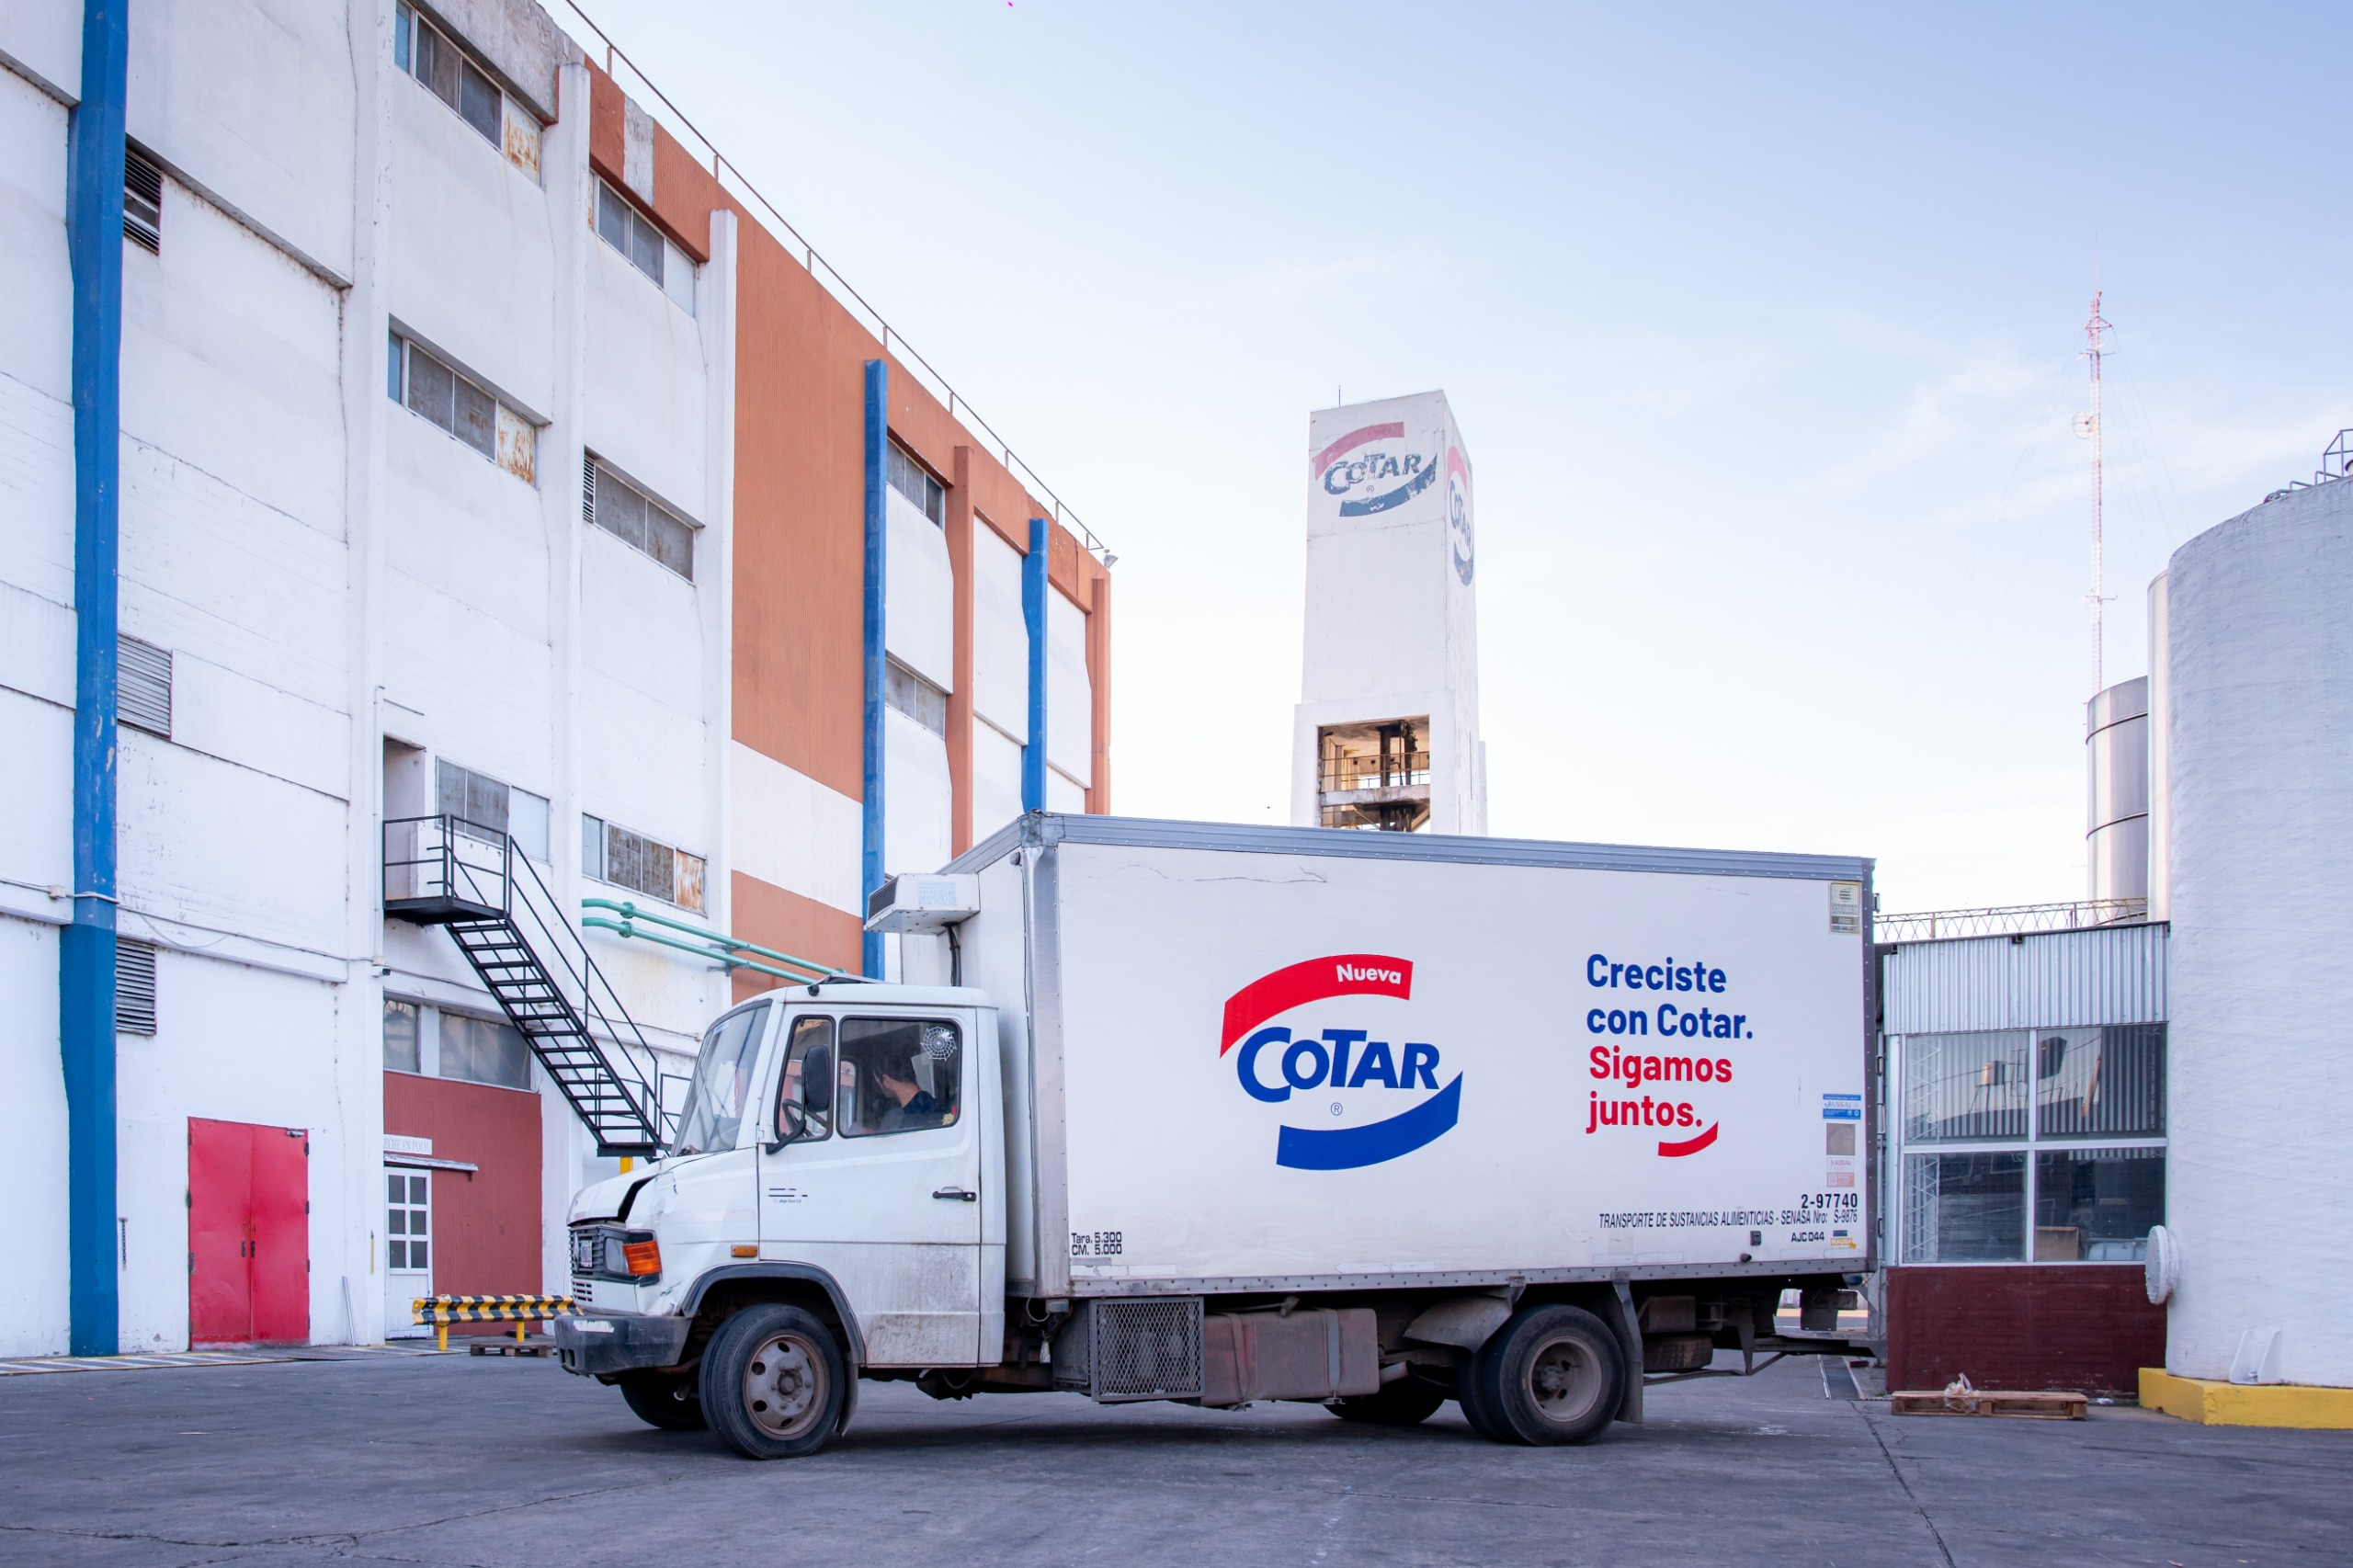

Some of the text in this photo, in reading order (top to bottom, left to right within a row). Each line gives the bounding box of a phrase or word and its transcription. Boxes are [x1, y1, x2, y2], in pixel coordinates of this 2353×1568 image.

[1336, 964, 1402, 984] Nueva
[1587, 954, 1727, 994] Creciste
[1587, 1003, 1754, 1040] con Cotar.
[1590, 1045, 1733, 1089] Sigamos
[1586, 1091, 1702, 1134] juntos.
[383, 1138, 402, 1150] ECHE
[1802, 1193, 1858, 1209] 2-97740
[1599, 1211, 1654, 1228] TRANSPORTE
[1656, 1211, 1667, 1227] DE
[1669, 1211, 1719, 1227] SUSTANCIAS
[1721, 1210, 1775, 1226] ALIMENTICIAS
[1781, 1209, 1812, 1224] SENASA
[1813, 1209, 1828, 1223] Nro:
[1071, 1231, 1122, 1244] Tara. 5.300
[1071, 1243, 1122, 1256] CM. 5.000
